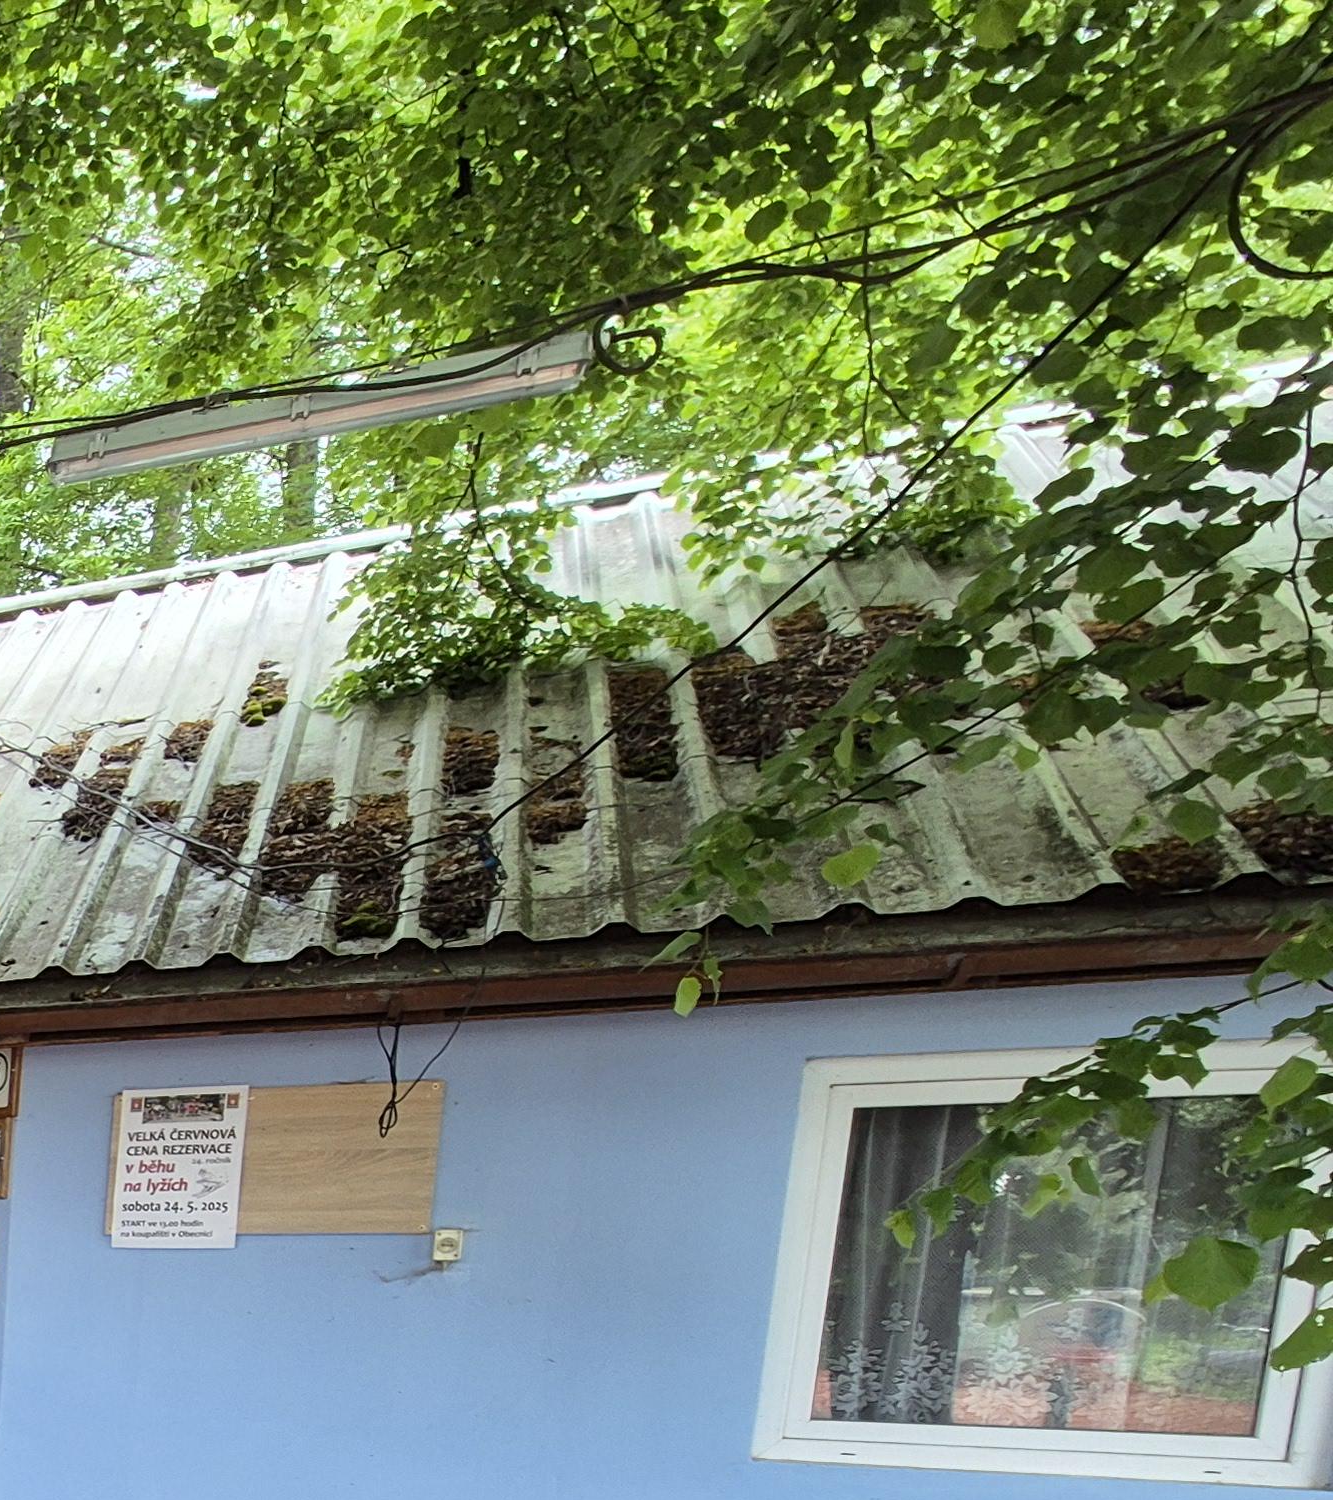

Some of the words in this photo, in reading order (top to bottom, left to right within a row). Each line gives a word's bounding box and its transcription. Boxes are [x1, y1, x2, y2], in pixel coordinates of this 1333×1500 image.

[128, 1128, 166, 1142] VELKÁ
[169, 1126, 237, 1141] ČERVNOVÁ
[126, 1145, 159, 1157] CENA
[162, 1143, 233, 1155] REZERVACE
[125, 1164, 135, 1174] v
[138, 1160, 176, 1174] běhu
[123, 1182, 142, 1192] na
[146, 1178, 188, 1195] lyžích
[122, 1201, 161, 1212] sobota
[164, 1201, 183, 1214] 24.
[187, 1201, 198, 1214] 5.
[202, 1201, 229, 1213] 2025
[180, 1219, 204, 1227] hodin
